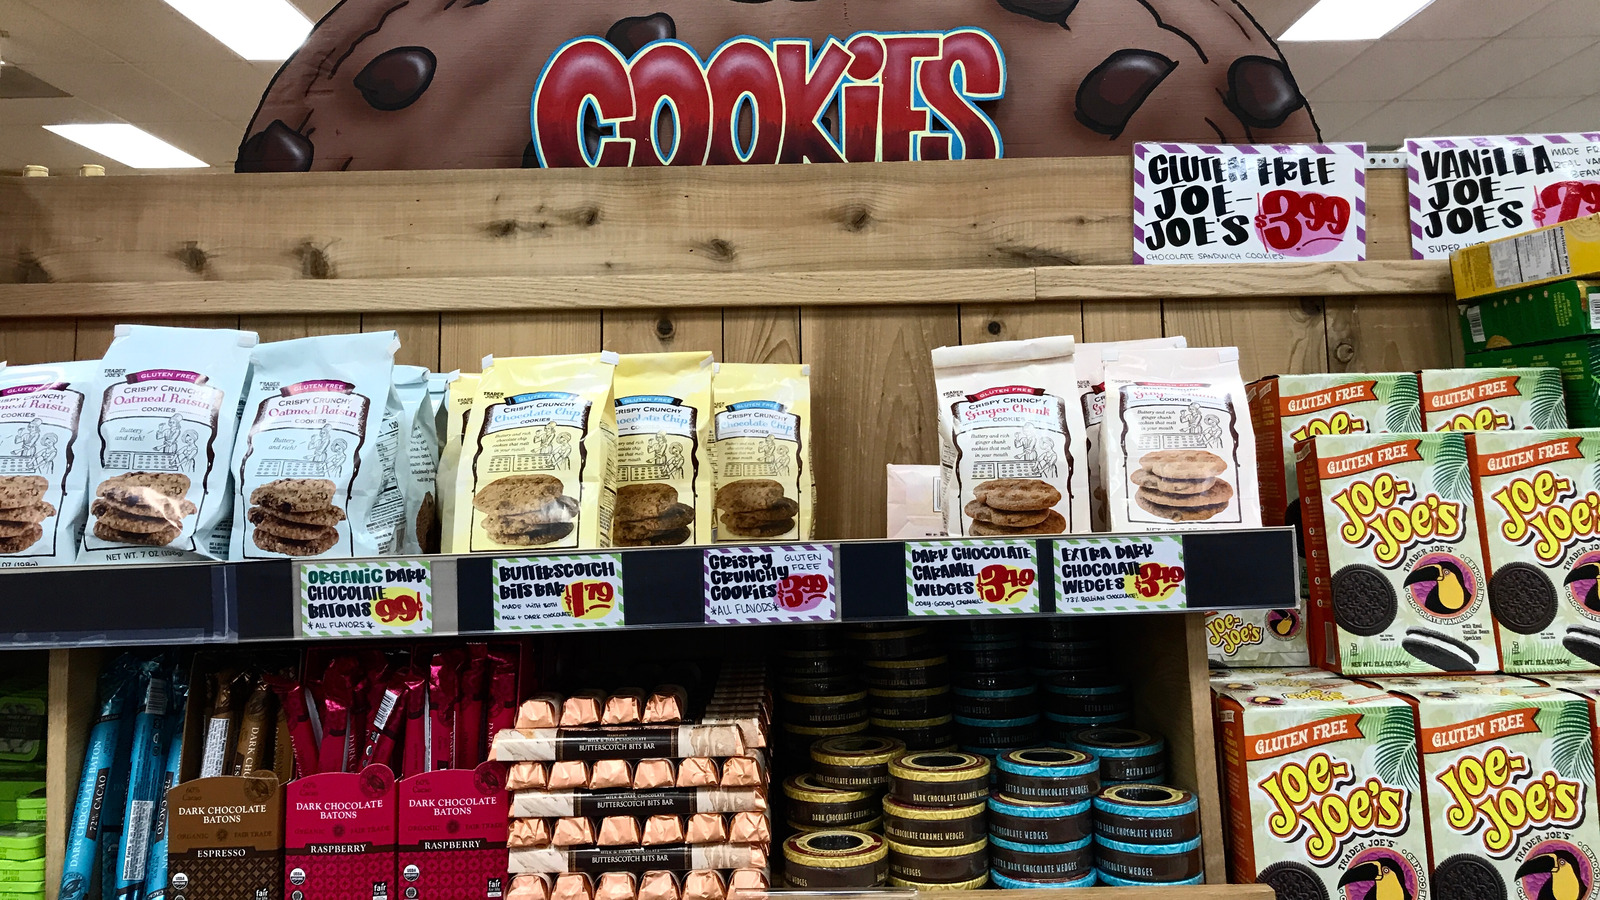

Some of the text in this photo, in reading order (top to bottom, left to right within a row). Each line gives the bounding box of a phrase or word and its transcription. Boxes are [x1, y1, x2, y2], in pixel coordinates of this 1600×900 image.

[532, 26, 1007, 168] COOKIES
[1551, 147, 1579, 156] MADE
[1258, 156, 1335, 186] FREE
[1421, 145, 1554, 181] VANILLA
[1428, 177, 1524, 210] JOE-
[1154, 185, 1252, 221] JOE-
[1145, 215, 1249, 250] JOE'S
[114, 393, 210, 410] Oatmeal Raisin
[1287, 384, 1364, 412] GLUTEN FREE
[1432, 381, 1507, 407] GLUTEN FREE
[269, 405, 357, 418] Oatmeal Raisin
[503, 405, 534, 413] CRISPY
[965, 404, 1050, 421] Ginger Chunk
[969, 399, 1000, 410] CRISPY
[495, 408, 580, 422] Chocolate Chip
[662, 414, 688, 428] Chip
[721, 419, 792, 434] Chocolate Chip
[1327, 444, 1408, 475] GLUTEN FREE
[1487, 442, 1569, 471] GLUTEN FREE
[1331, 471, 1410, 543] Joe-
[1491, 470, 1570, 543] Joe-
[1368, 492, 1459, 562] Joe's
[784, 554, 822, 562] GLUTEN
[912, 546, 1031, 563] DARK CHOCOLATE
[1061, 543, 1154, 562] EXTRA DARK
[1403, 545, 1453, 572] TRADER JOE'S
[1563, 546, 1588, 571] TRADER
[709, 554, 772, 570] CRISPY
[1061, 561, 1141, 578] CHOCOLATE
[308, 568, 426, 584] ORGANIC DARK
[499, 562, 615, 582] BUTTERSCOTCH
[710, 566, 789, 585] CRUNCHY
[912, 562, 980, 581] CARAMEL
[307, 585, 388, 601] CHOCOLATE
[499, 582, 566, 600] BITS BAR
[710, 584, 777, 601] COOKIES
[914, 582, 974, 596] WEDGES
[1062, 578, 1125, 594] WEDGES
[307, 602, 372, 619] BATONS
[375, 592, 423, 623] 99¢
[1406, 589, 1484, 625] CHOCOLATE VANILLA CREME
[1206, 614, 1240, 645] Joe-
[1220, 623, 1261, 653] Joe's
[1255, 721, 1348, 755] GLUTEN FREE
[1431, 714, 1525, 748] GLUTEN FREE
[849, 777, 872, 785] CARAMEL
[1439, 746, 1527, 831] Joe-
[94, 775, 106, 810] CACAO
[913, 792, 977, 803] DARK CHOCOLATE CARAMEL
[1005, 784, 1089, 796] EXTRA DARK WEDGES
[1258, 751, 1349, 837] Joe-
[70, 740, 101, 867] DARK CHOCOLATE BATON
[178, 804, 266, 815] DARK CHOCOLATE
[296, 799, 383, 810] DARK CHOCOLATE
[409, 796, 497, 807] DARK CHOCOLATE
[597, 801, 646, 809] BUTTERSCOTCH
[203, 815, 241, 824] BATONS
[320, 811, 357, 819] BATONS
[434, 807, 472, 816] BATONS
[812, 813, 825, 821] DARK
[1299, 777, 1407, 861] Joe's
[1477, 771, 1582, 854] Joe's
[919, 831, 964, 841] CARAMEL WEDGES
[1024, 831, 1048, 840] WEDGES
[1149, 829, 1173, 839] WEDGES
[197, 848, 246, 858] ESPRESSO
[310, 844, 366, 853] RASPBERRY
[424, 840, 480, 849] RASPBERRY
[1514, 835, 1543, 863] TRADER
[1338, 842, 1366, 871] TRADER
[1007, 861, 1077, 873] DARK CHOCOLATE WEDGES
[1128, 866, 1153, 876] WEDGES
